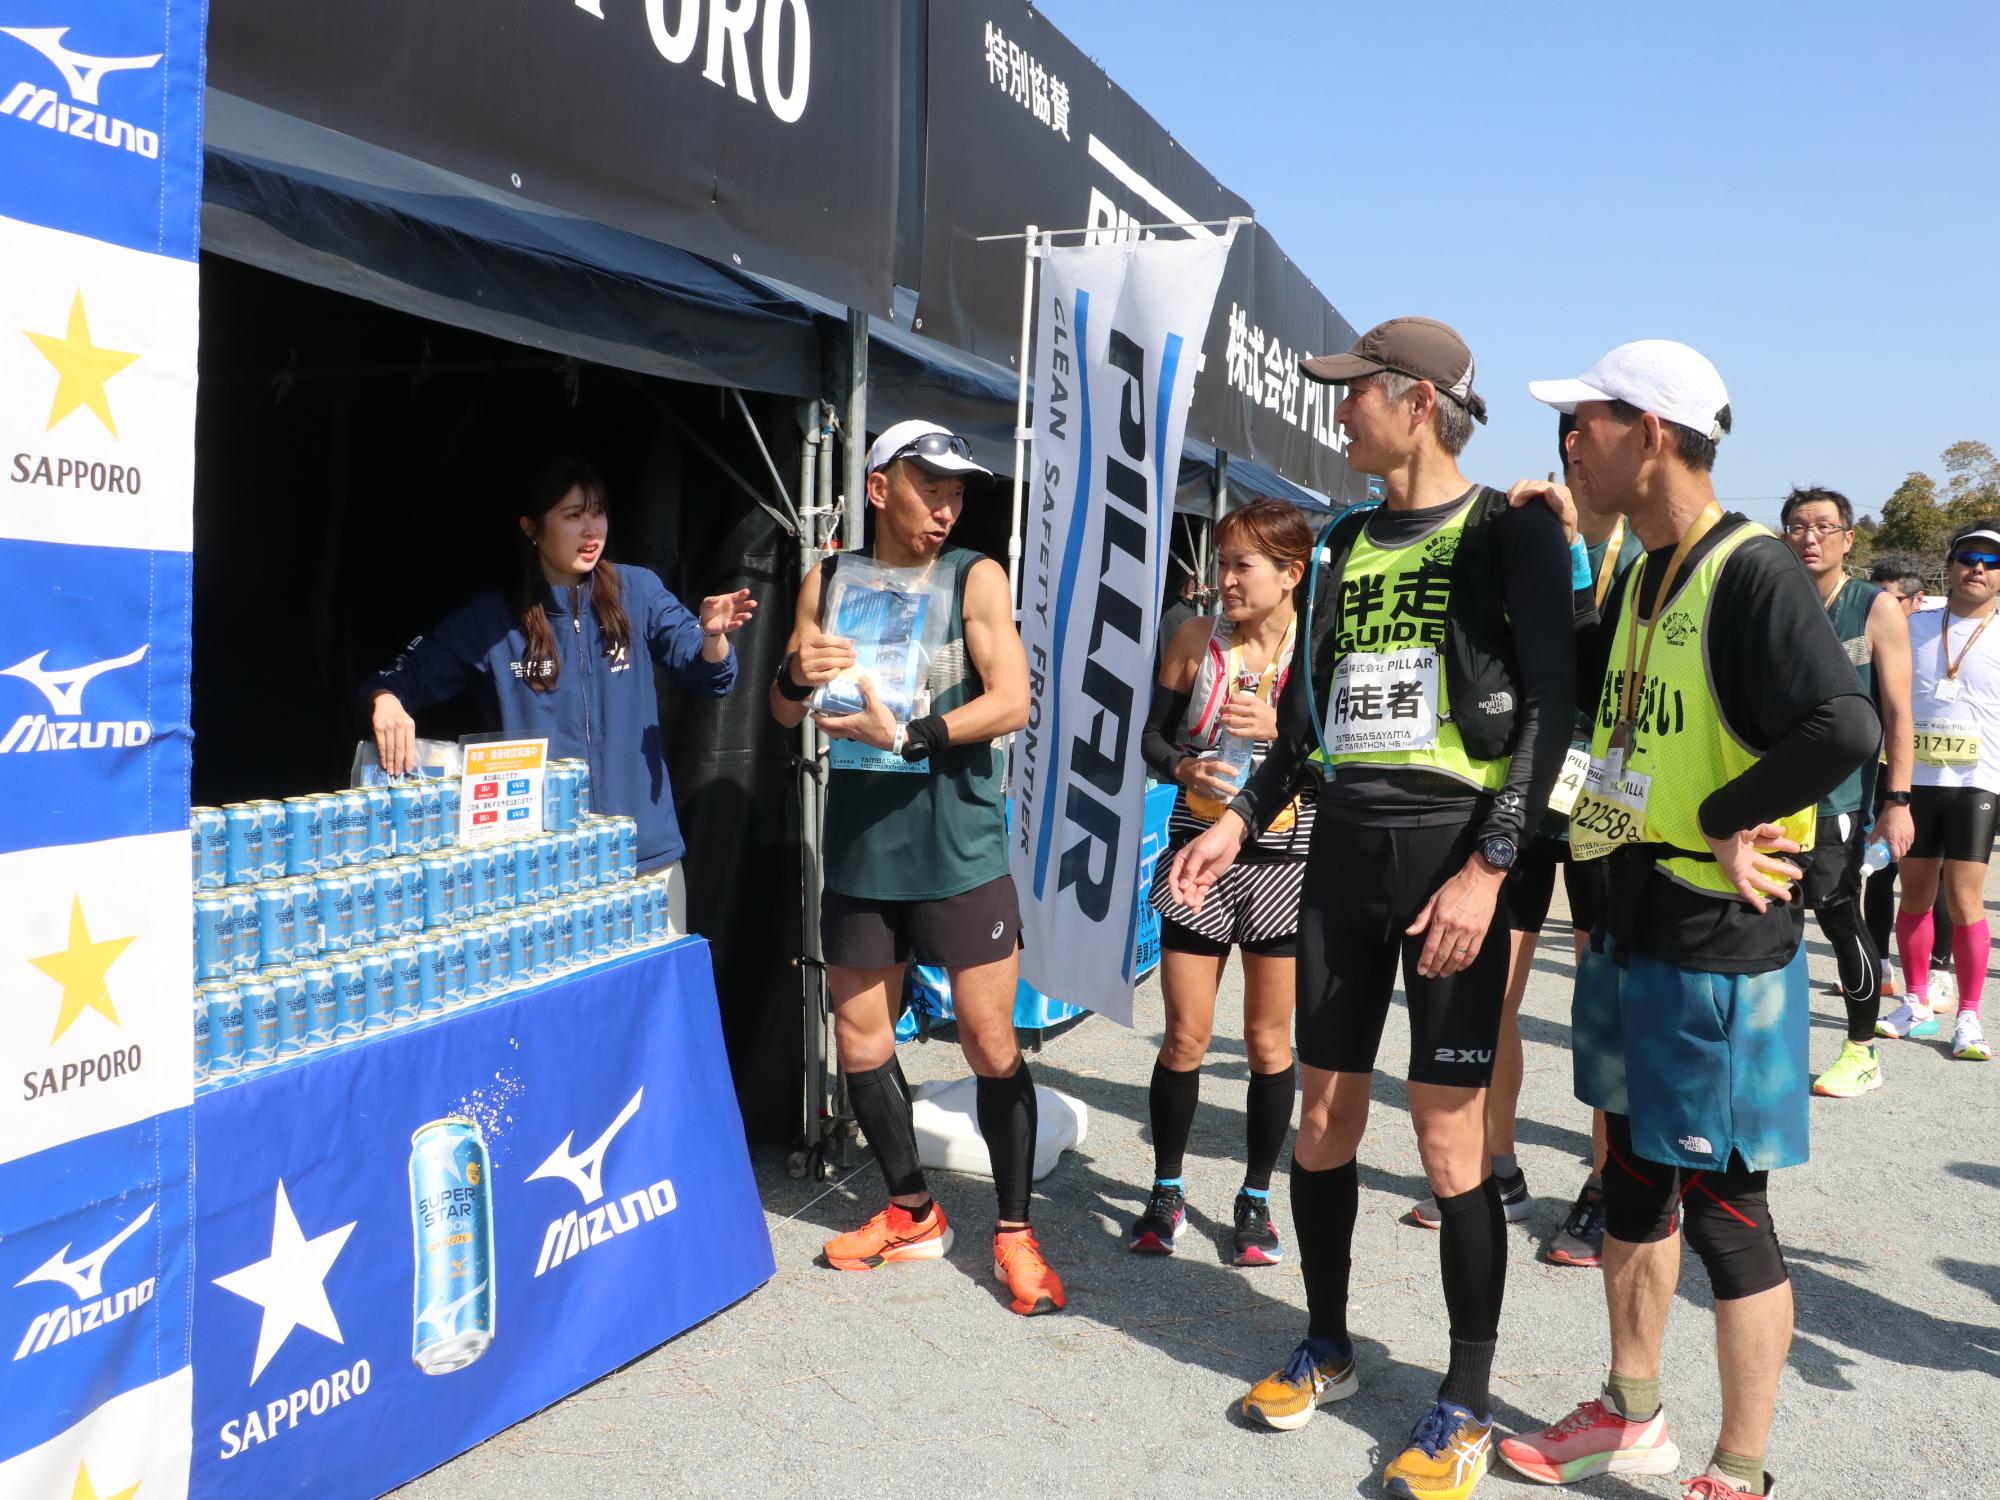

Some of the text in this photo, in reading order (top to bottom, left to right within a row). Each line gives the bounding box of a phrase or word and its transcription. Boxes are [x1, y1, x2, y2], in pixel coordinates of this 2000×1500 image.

[985, 20, 1070, 142] 特別協賛
[0, 81, 159, 160] MIZUNO
[1226, 302, 1300, 426] 株式会社
[11, 453, 142, 496] SAPPORO
[1020, 296, 1070, 857] CLEAN SAFETY FRONTIER
[1334, 557, 1453, 635] 伴走
[1057, 329, 1148, 923] PILLAR
[1335, 621, 1446, 653] GUIDE
[1387, 658, 1433, 672] PILLAR
[0, 714, 153, 753] MIZUNO
[1913, 734, 1977, 754] 31717 B
[1570, 796, 1631, 841] 32258
[23, 1043, 142, 1101] SAPPORO
[1434, 1048, 1492, 1064] 2XU
[419, 1187, 477, 1215] SUPER
[424, 1203, 473, 1229] STAR
[534, 1178, 677, 1279] MIZUNO
[13, 1276, 156, 1362] MIZUNO
[220, 1359, 371, 1460] SAPPORO
